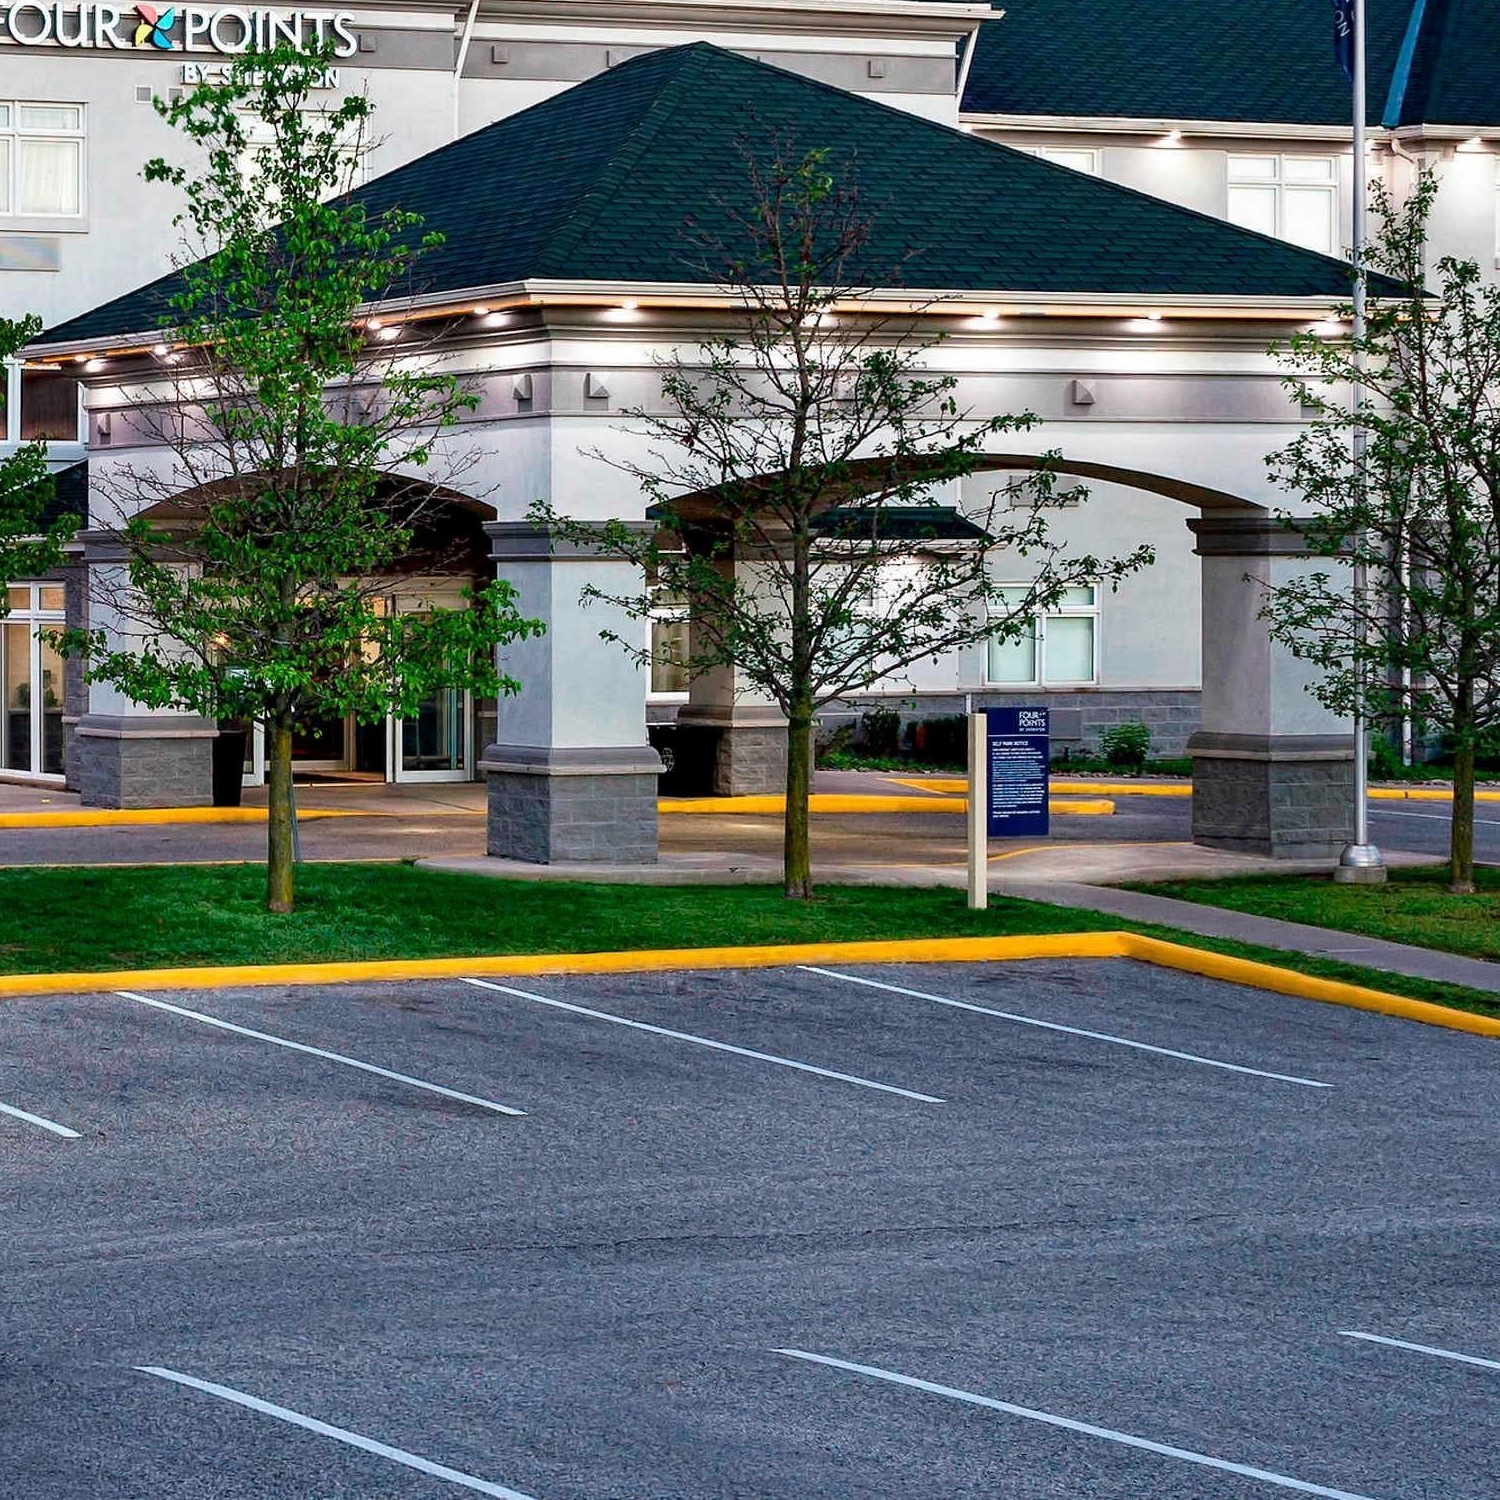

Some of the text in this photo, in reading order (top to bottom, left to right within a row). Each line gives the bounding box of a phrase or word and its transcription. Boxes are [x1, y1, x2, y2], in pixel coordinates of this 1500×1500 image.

[182, 6, 358, 58] POINTS
[182, 62, 209, 85] BY
[1019, 711, 1040, 719] FOUR
[1019, 719, 1046, 727] POINTS
